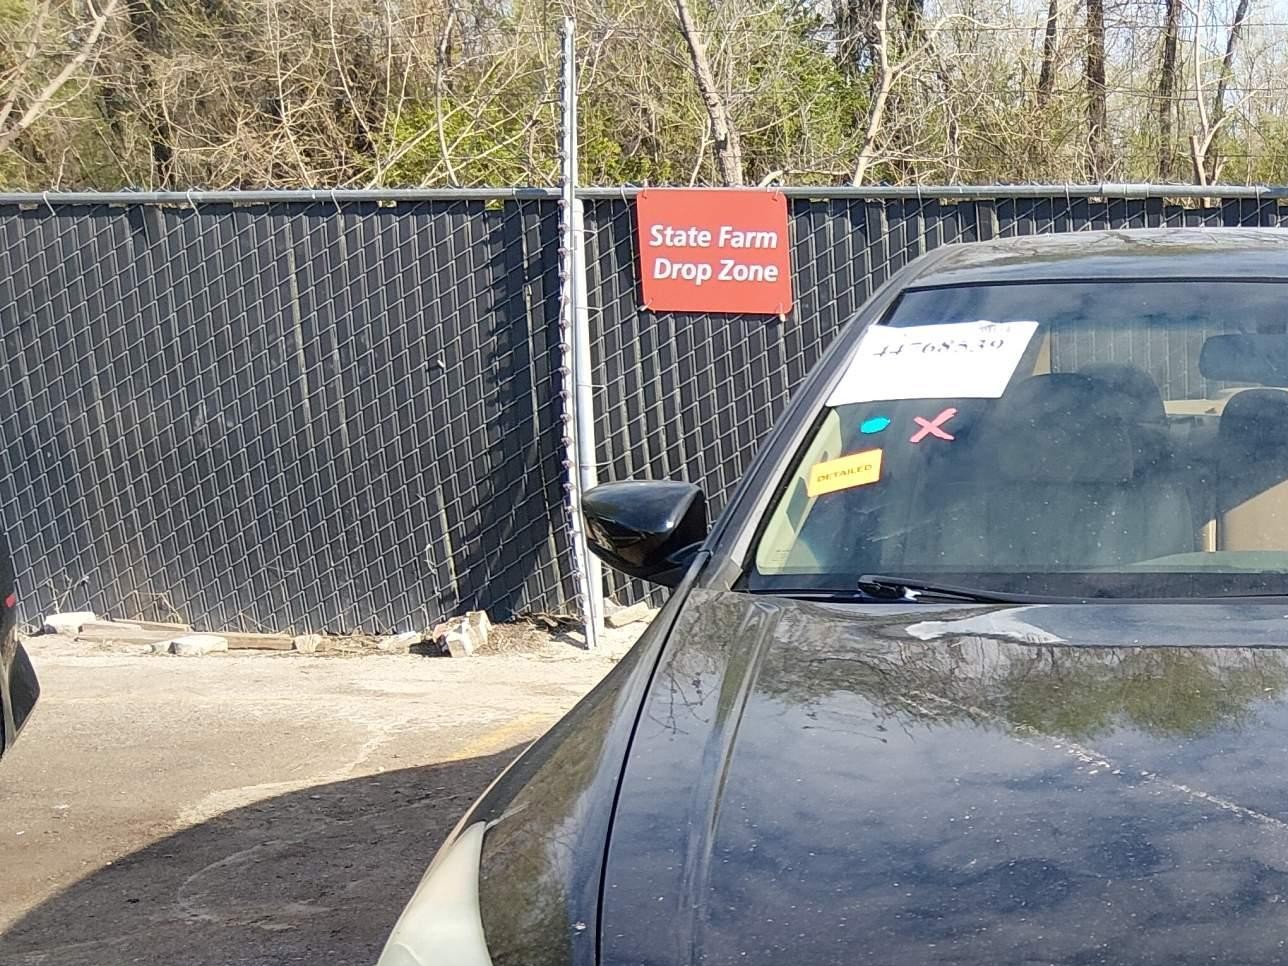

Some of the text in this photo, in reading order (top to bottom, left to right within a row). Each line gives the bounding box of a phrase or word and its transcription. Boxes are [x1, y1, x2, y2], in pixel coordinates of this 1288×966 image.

[649, 224, 778, 249] State Farm
[653, 258, 779, 286] Drop Zone
[816, 464, 873, 482] DETAILED
